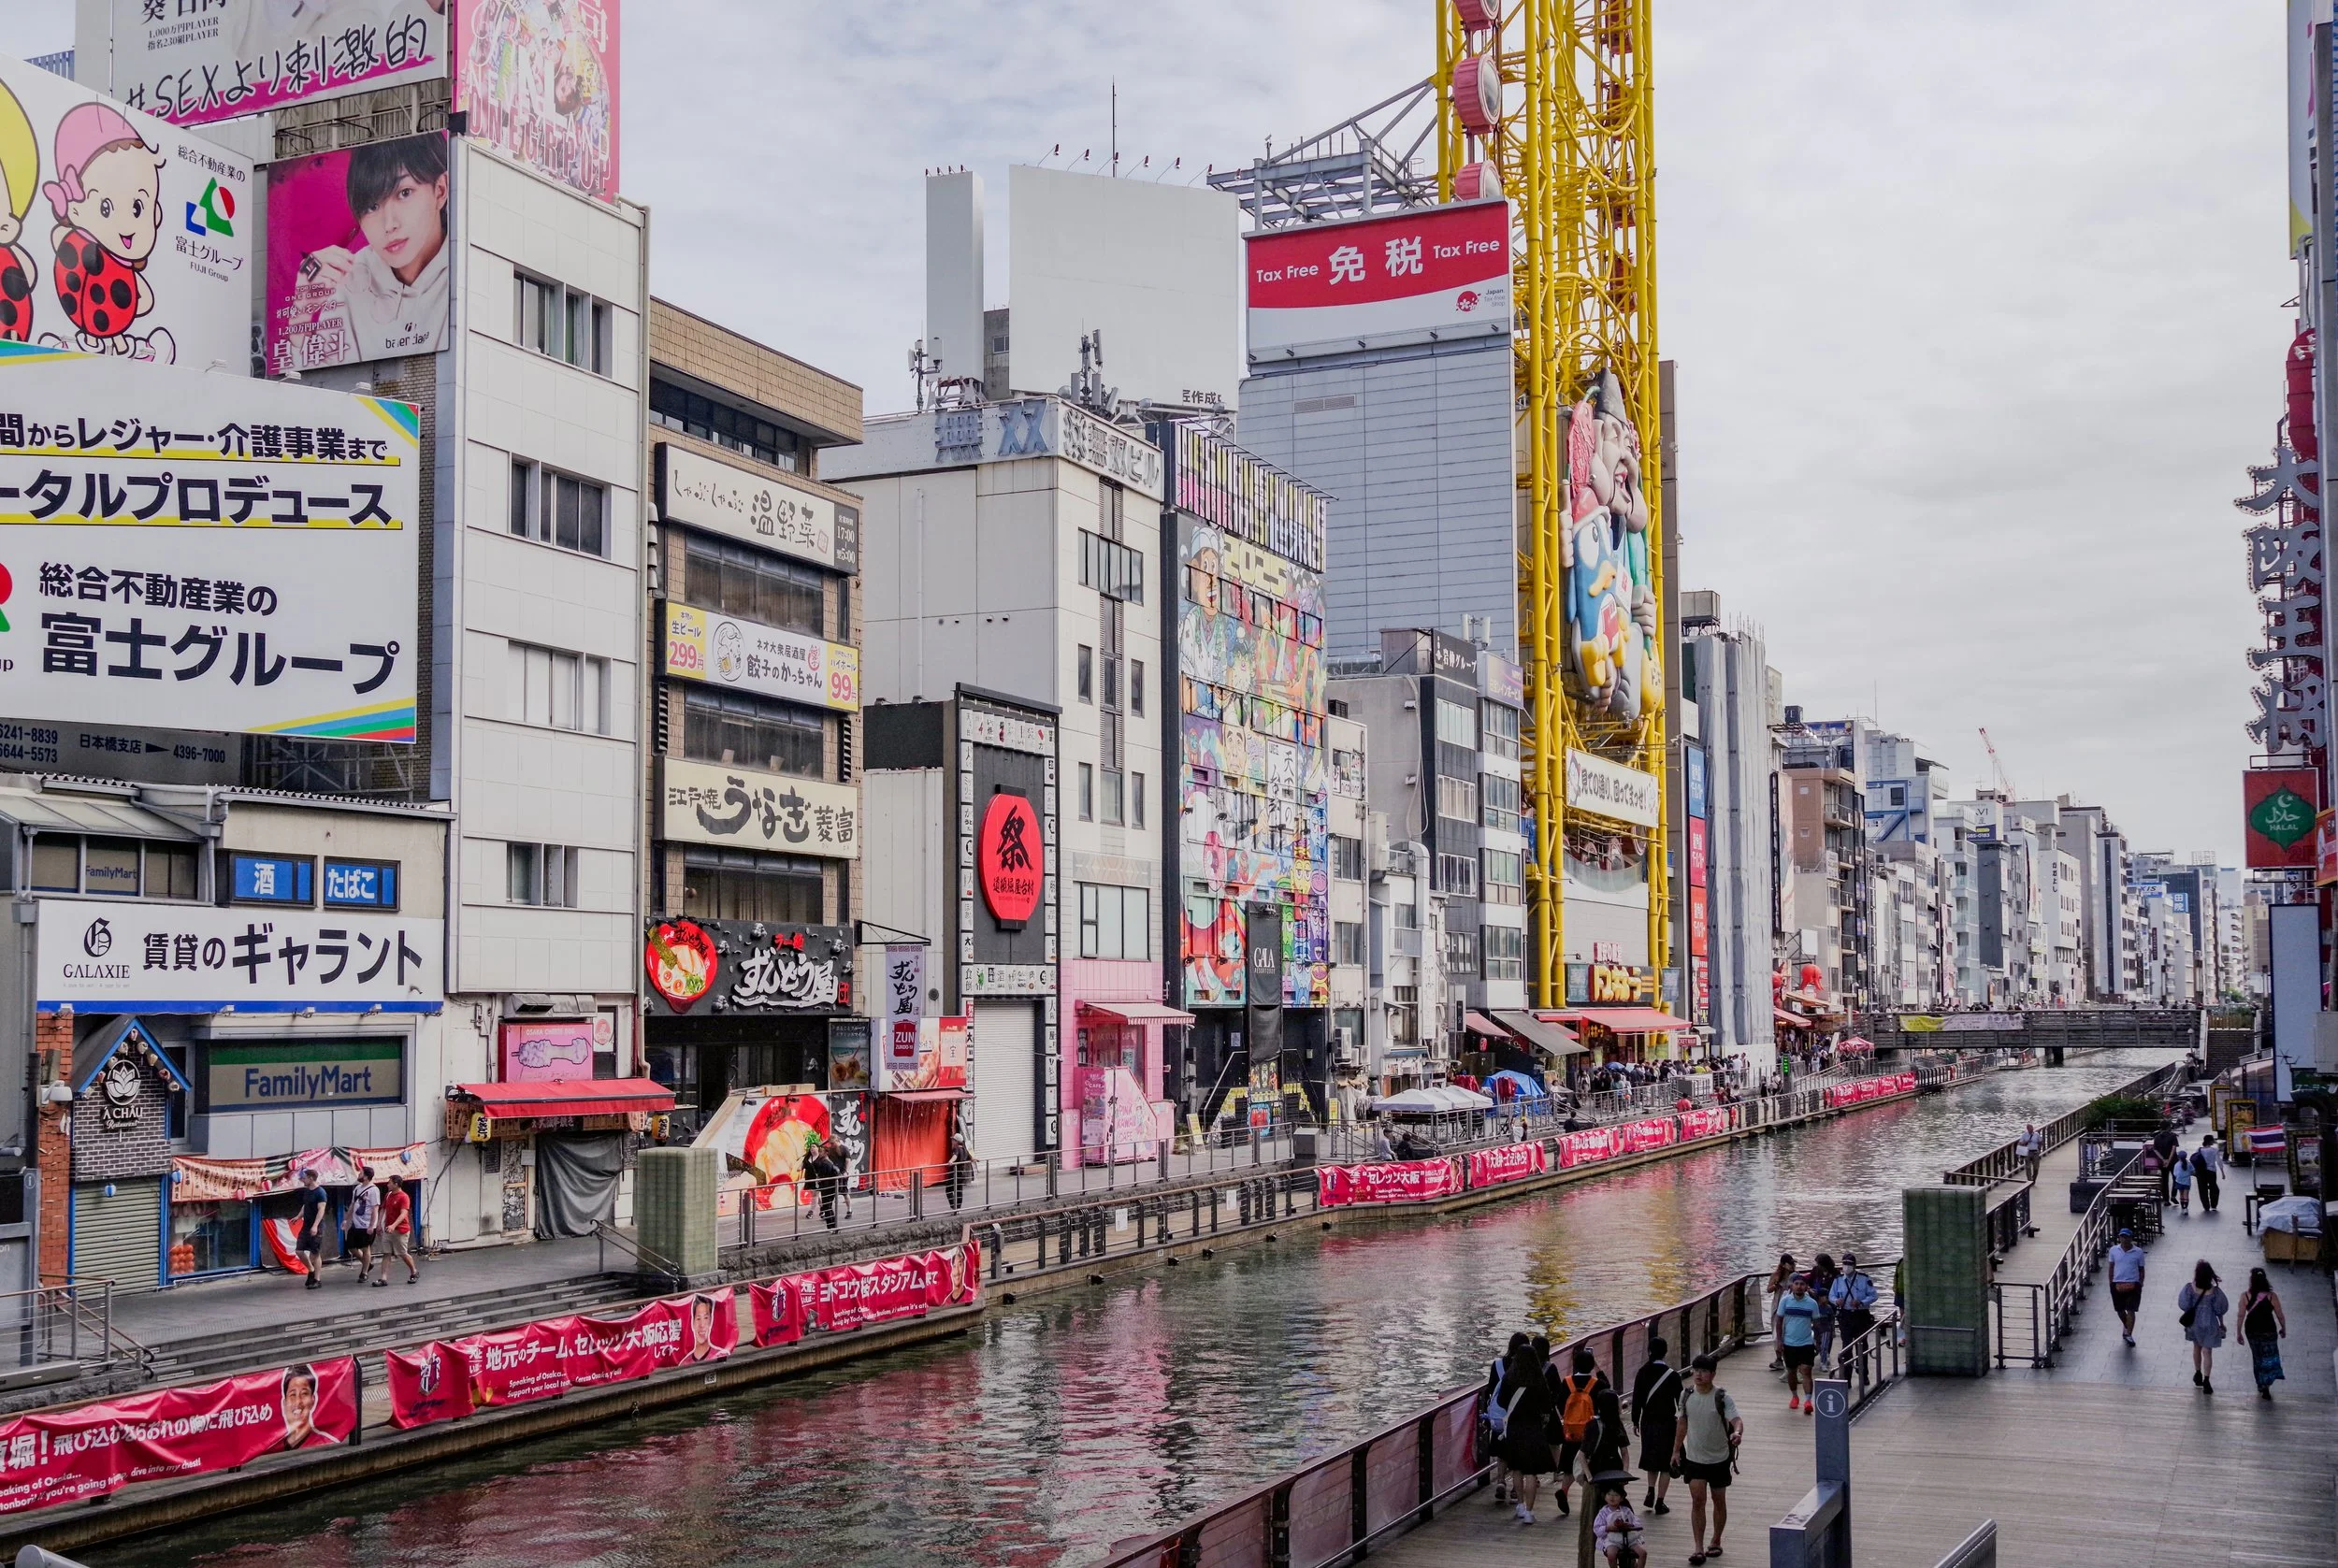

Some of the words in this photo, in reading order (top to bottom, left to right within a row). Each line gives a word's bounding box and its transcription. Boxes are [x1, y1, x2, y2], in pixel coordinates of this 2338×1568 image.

[148, 28, 219, 50] 指名230組PLAYER
[149, 17, 219, 38] 1,000万円PLAYER
[126, 14, 426, 118] #SEXより刺激的
[178, 144, 246, 182] 総合不動産業の
[176, 236, 244, 270] 富士グループ
[1256, 268, 1282, 282] Tax
[1287, 264, 1319, 279] Free
[1433, 244, 1461, 259] Tax
[1465, 239, 1500, 255] Free
[190, 261, 207, 274] FUJI
[209, 267, 229, 282] Group
[278, 318, 343, 337] 1,200万円PLAYER
[0, 413, 387, 461] 間からレジャー・介護事業まで
[674, 469, 743, 513] しゃぶしゃぶ
[750, 490, 815, 549] 温野菜
[837, 525, 855, 543] 17:00
[1223, 534, 1288, 598] 2025
[39, 562, 278, 616] 総合不動産業の
[2233, 446, 2326, 752] 大阪王将
[671, 620, 701, 639] 生ビール
[41, 611, 401, 696] 富士グループ
[757, 640, 806, 662] ネオ大衆居酒屋
[830, 659, 856, 671] ハイボール
[747, 655, 823, 689] 餃子のかっちゃん
[79, 733, 142, 755] 日本橋支店
[173, 744, 226, 764] 4396-7000
[668, 785, 720, 810] 江戸焼
[697, 776, 812, 844] うなぎ
[2265, 806, 2301, 824] حلال
[996, 804, 1034, 873] 祭
[85, 864, 137, 880] FamilyMart
[254, 863, 275, 895] 酒
[327, 868, 375, 899] たばこ
[143, 923, 422, 986] 賃貸のギャラント
[1254, 946, 1275, 968] GALA
[64, 963, 130, 979] GALAXIE
[734, 947, 839, 1007] ずんどう屋
[895, 1031, 915, 1043] ZUN
[245, 1065, 372, 1100] FamilyMart
[508, 1388, 530, 1399] Support
[531, 1386, 543, 1396] your
[543, 1382, 559, 1392] local
[510, 1375, 535, 1388] Speaking
[536, 1374, 542, 1382] of
[32, 1477, 42, 1489] of
[46, 1485, 75, 1501] you're
[78, 1478, 106, 1493] going
[130, 1467, 147, 1477] dive
[148, 1463, 165, 1474] into
[166, 1463, 180, 1474] my
